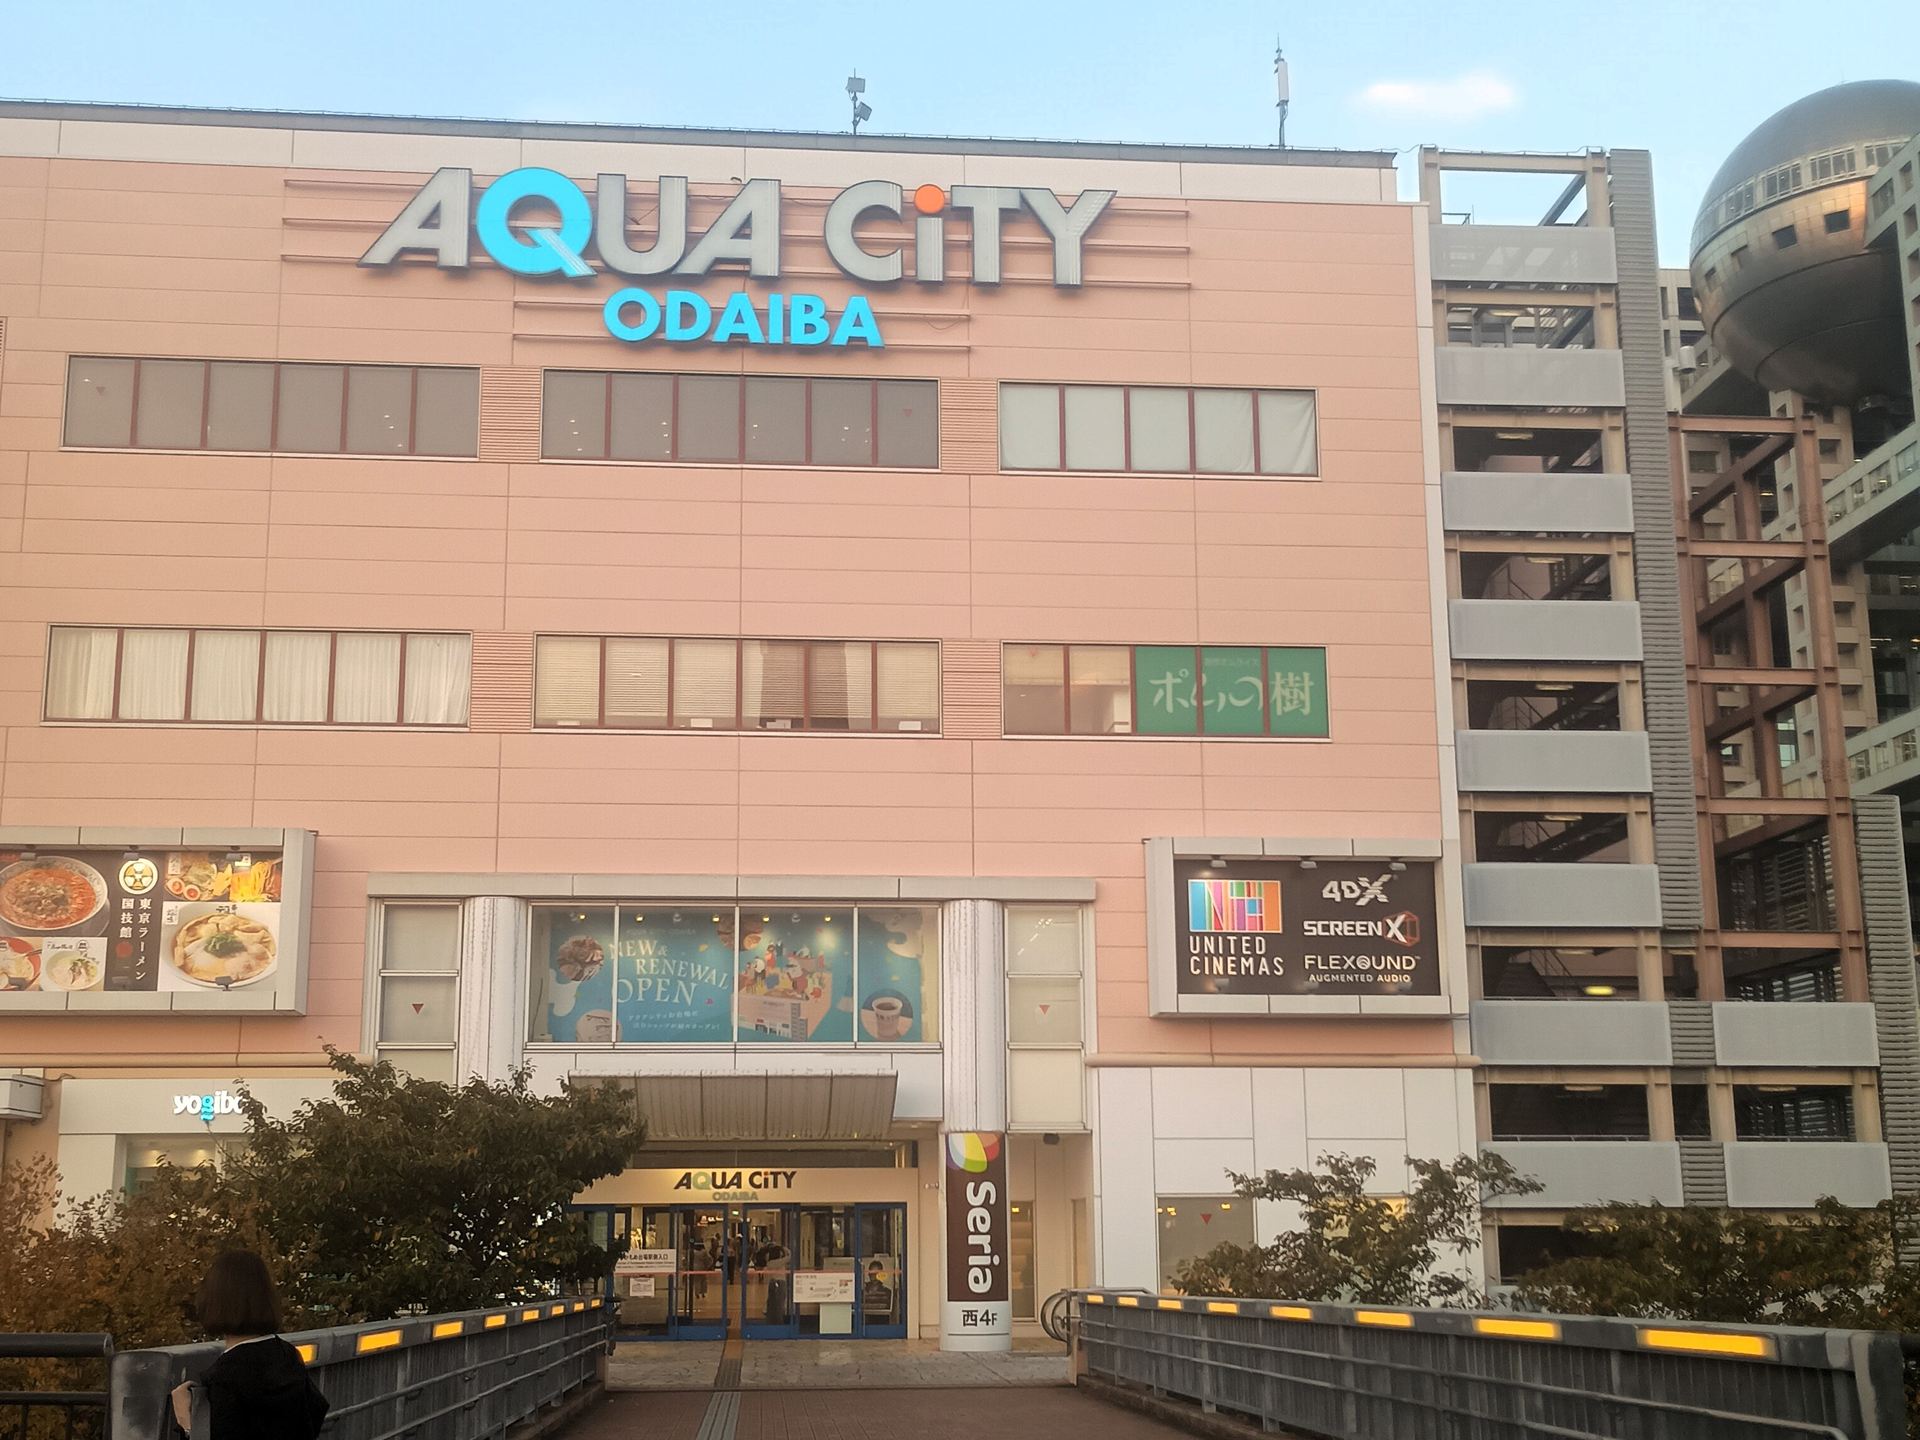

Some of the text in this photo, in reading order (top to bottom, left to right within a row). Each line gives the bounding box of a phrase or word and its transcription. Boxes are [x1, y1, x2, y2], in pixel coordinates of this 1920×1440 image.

[357, 166, 782, 278] AQUA
[602, 287, 885, 348] ODAIBA
[1321, 874, 1393, 906] 4DX
[119, 898, 135, 938] 国技館
[136, 898, 152, 980] 東京ラーメン
[1190, 936, 1266, 955] UNITED
[635, 958, 729, 990] RENEWAL
[1190, 956, 1284, 976] CINEMAS
[1309, 974, 1411, 983] AUGMENTED AUDIO
[612, 977, 698, 1007] OPEN
[673, 1171, 742, 1190] AQUA
[712, 1191, 759, 1201] ODAIBA
[966, 1181, 1000, 1294] Seria
[962, 1309, 998, 1327] 西4F
